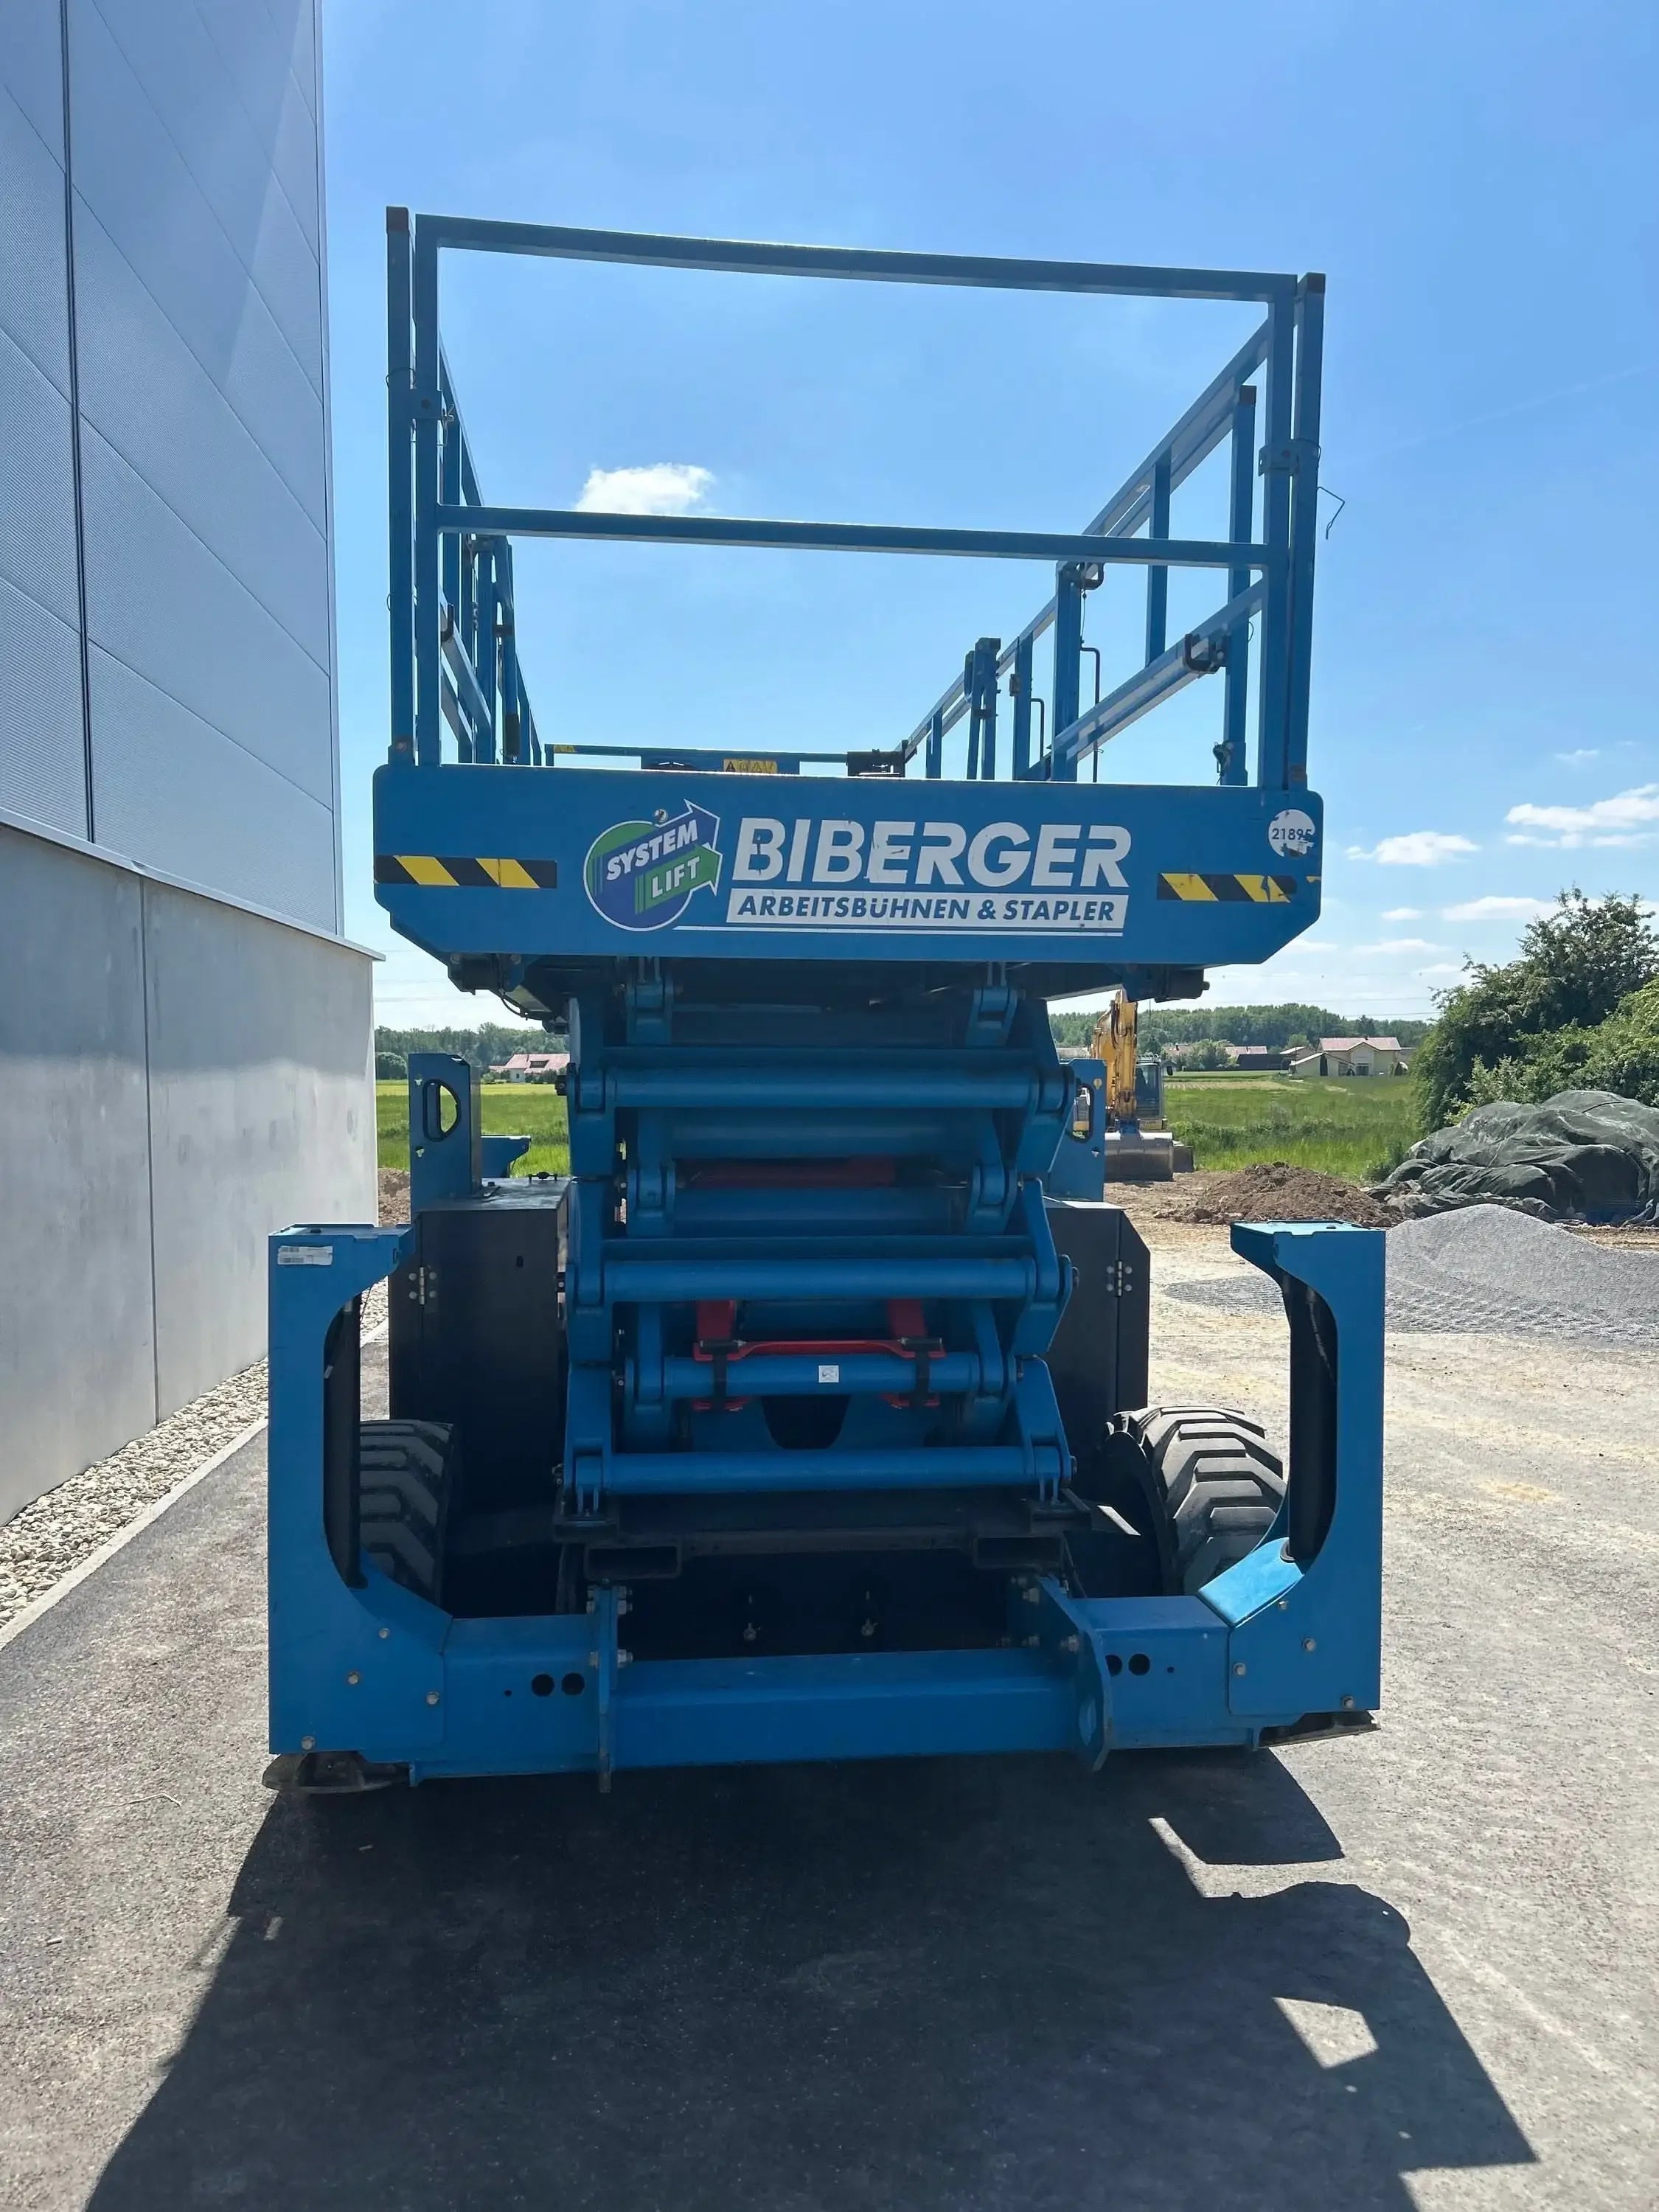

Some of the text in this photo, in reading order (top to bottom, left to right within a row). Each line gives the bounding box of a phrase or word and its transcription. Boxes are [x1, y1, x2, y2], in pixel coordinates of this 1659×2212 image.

[606, 819, 698, 880] SYSTEM
[731, 817, 1132, 888] BIBERGER
[652, 856, 700, 898] LIFT
[737, 895, 1115, 921] ARBEITSBÜHNEN & STAPLER
